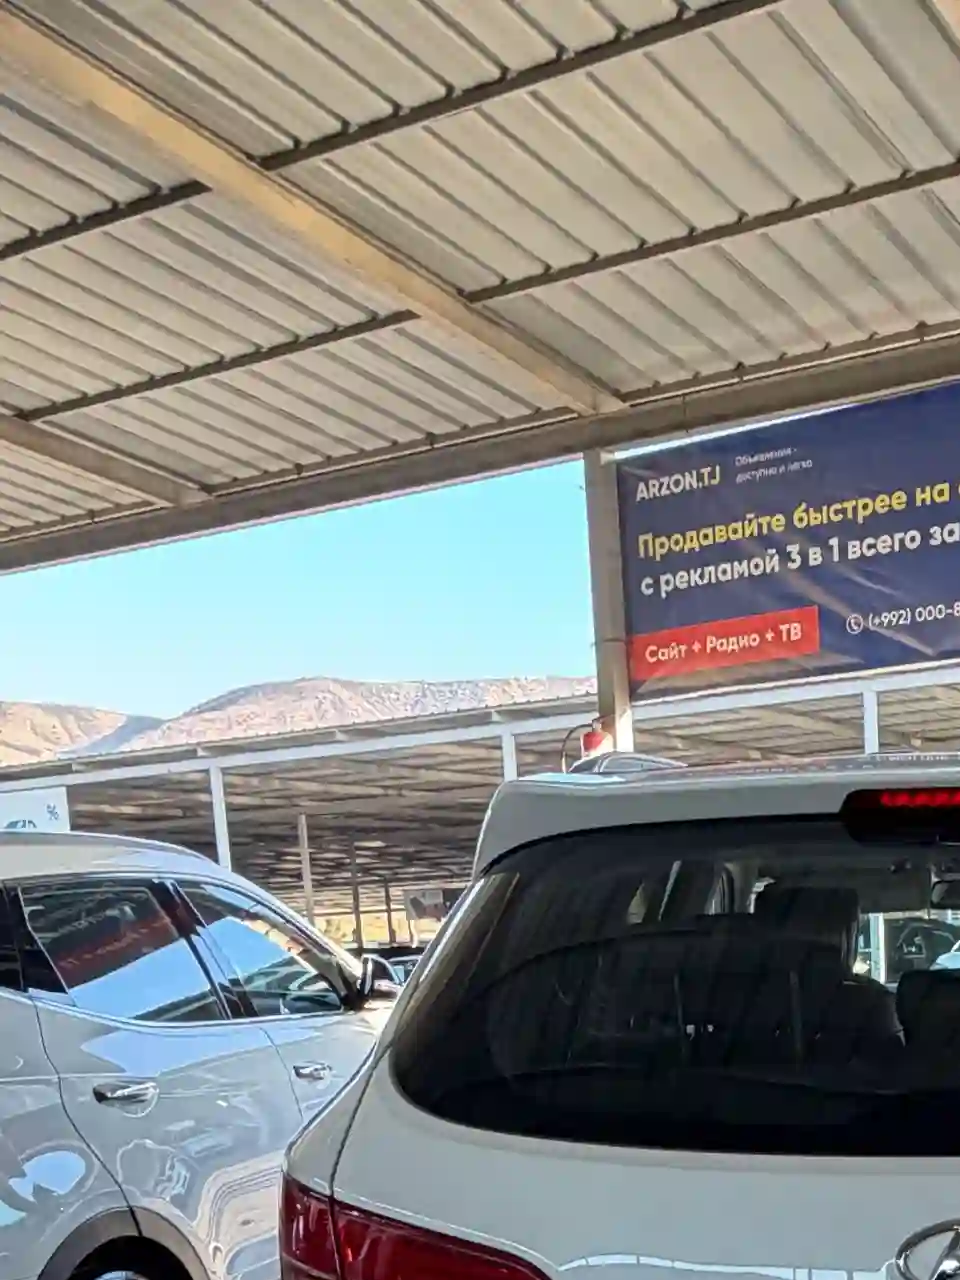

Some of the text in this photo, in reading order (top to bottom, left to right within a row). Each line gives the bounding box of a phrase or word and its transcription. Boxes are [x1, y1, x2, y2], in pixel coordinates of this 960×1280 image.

[635, 465, 722, 502] ARZON.TJ
[637, 513, 786, 561] Продавайте
[792, 489, 907, 530] быстрее
[915, 480, 951, 506] на
[640, 576, 655, 596] с
[660, 547, 780, 599] рекламой
[786, 542, 803, 571] 3
[808, 549, 823, 566] в
[828, 537, 840, 562] 1
[847, 529, 922, 560] всего
[928, 520, 960, 547] за
[868, 607, 913, 628] (+992)
[644, 639, 686, 663] Сайт
[706, 628, 760, 653] Радио
[779, 622, 802, 642] ТВ
